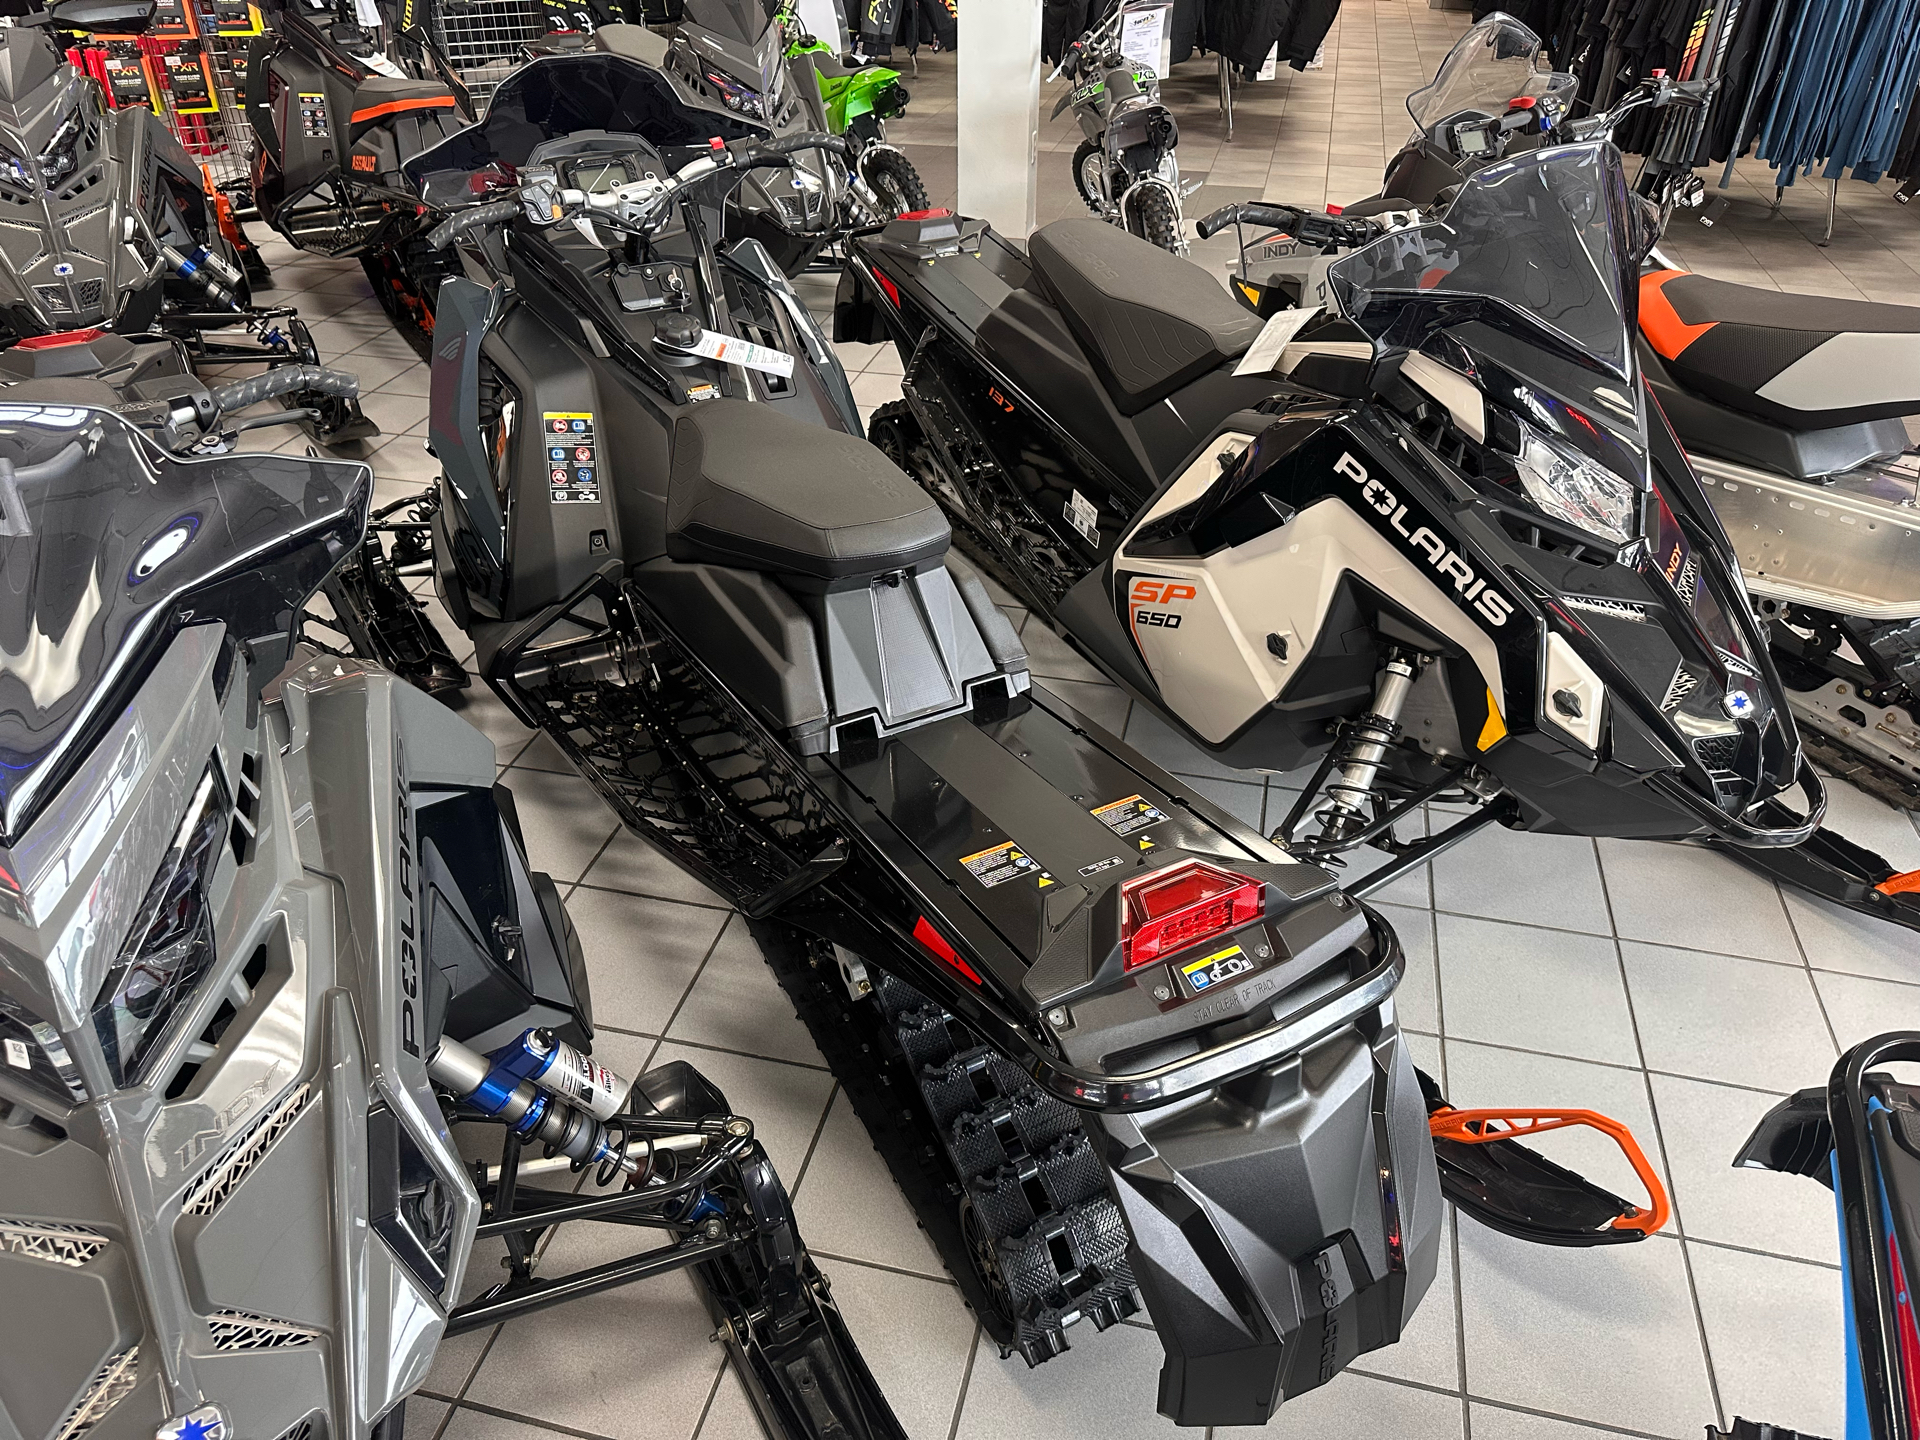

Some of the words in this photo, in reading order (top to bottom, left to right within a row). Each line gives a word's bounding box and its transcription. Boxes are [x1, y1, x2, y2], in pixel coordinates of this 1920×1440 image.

[111, 65, 140, 77] FXR
[171, 62, 199, 73] FXR
[232, 58, 248, 69] FX
[352, 155, 377, 172] ASSAULT
[1262, 242, 1299, 260] INDY
[988, 386, 1015, 413] 137
[1332, 451, 1515, 627] POLARIS
[1665, 541, 1682, 583] INDY
[1131, 580, 1197, 605] SP
[1136, 610, 1182, 629] 650
[395, 730, 421, 1060] POLARIS
[1193, 1007, 1213, 1023] STAY
[1216, 994, 1240, 1014] CLEAR
[1242, 989, 1252, 1001] OF
[1254, 978, 1277, 997] TRACK
[174, 1059, 281, 1172] INDY
[1312, 1251, 1341, 1384] POLARIS
